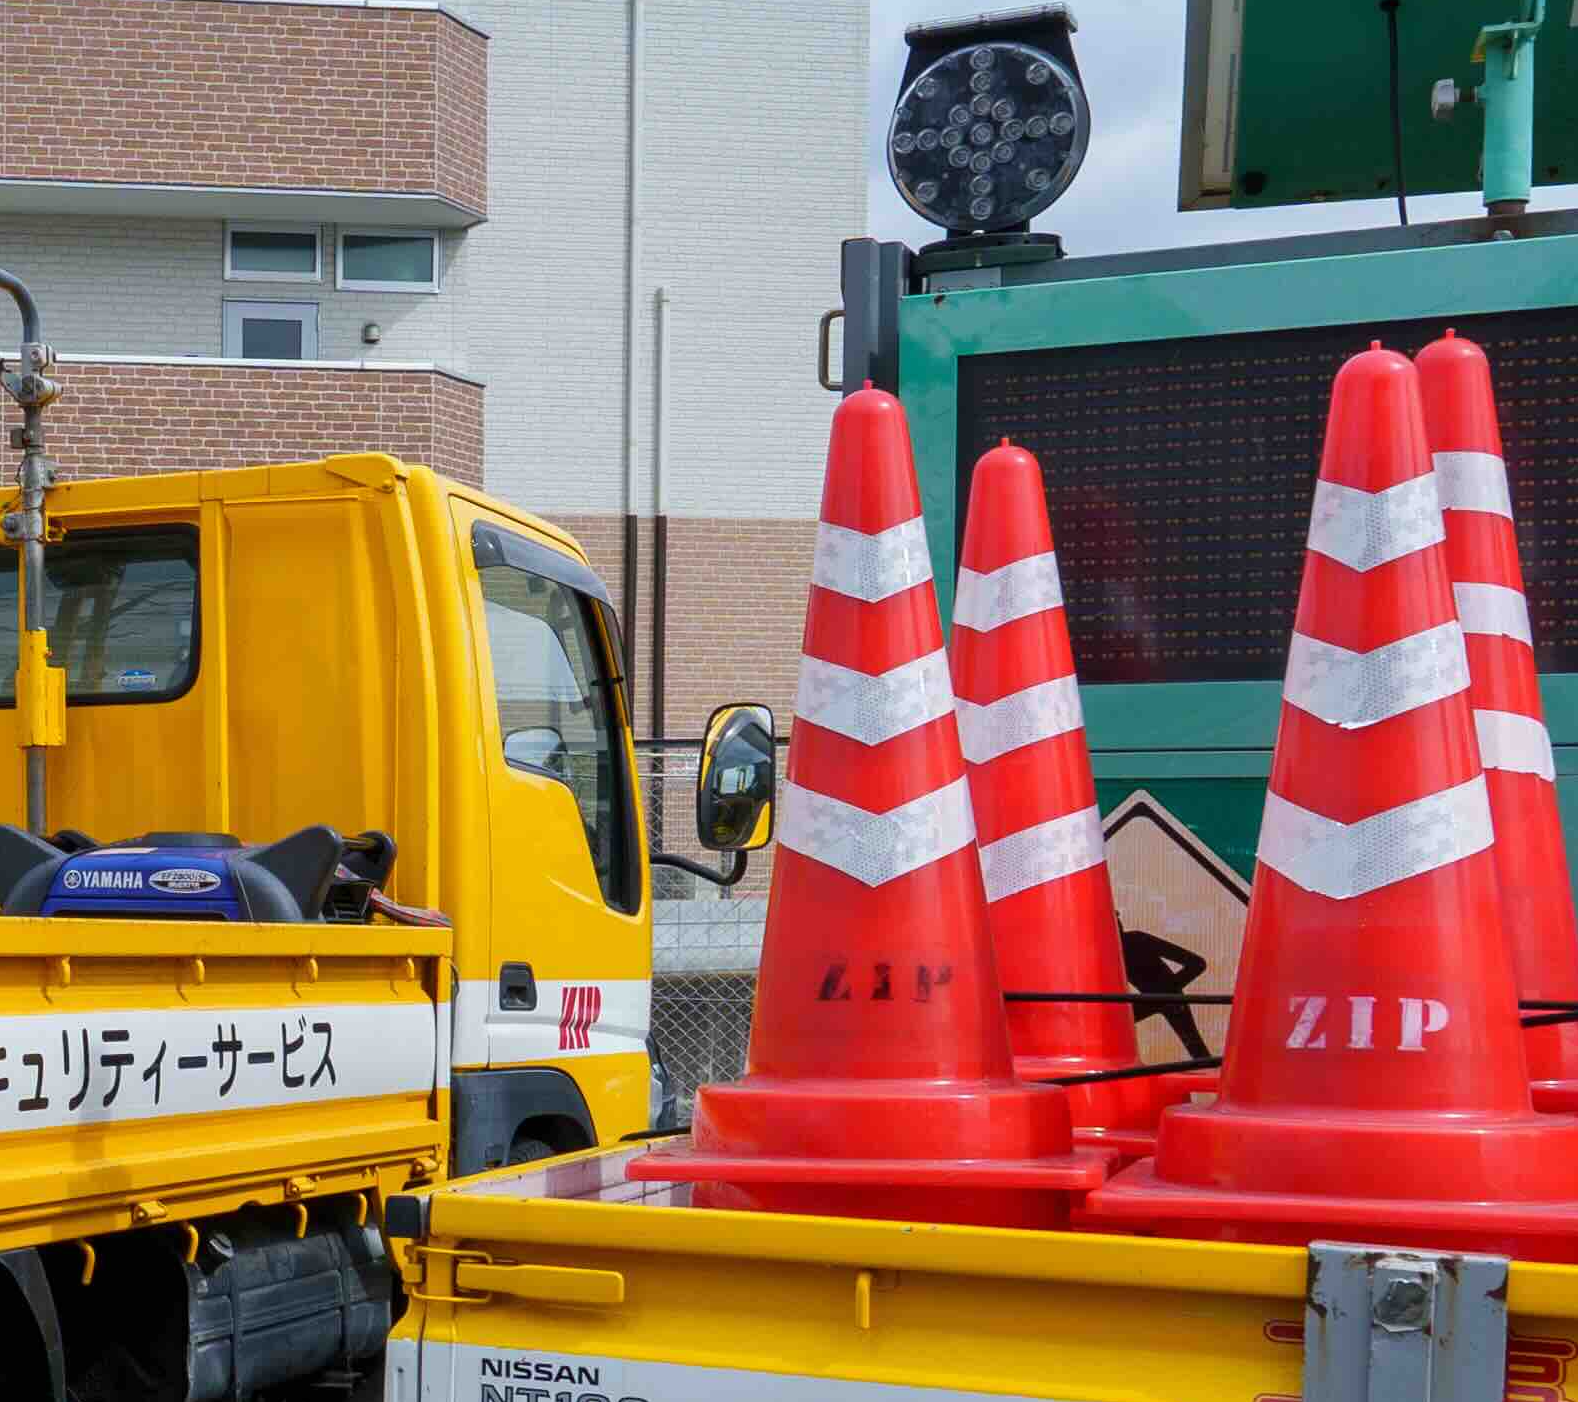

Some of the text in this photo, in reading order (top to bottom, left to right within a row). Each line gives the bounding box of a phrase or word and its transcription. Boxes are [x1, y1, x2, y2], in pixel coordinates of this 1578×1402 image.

[82, 871, 143, 889] YAMAHA
[816, 961, 953, 1002] ZIP
[1285, 994, 1450, 1052] ZIP
[481, 1357, 599, 1386] NISSAN
